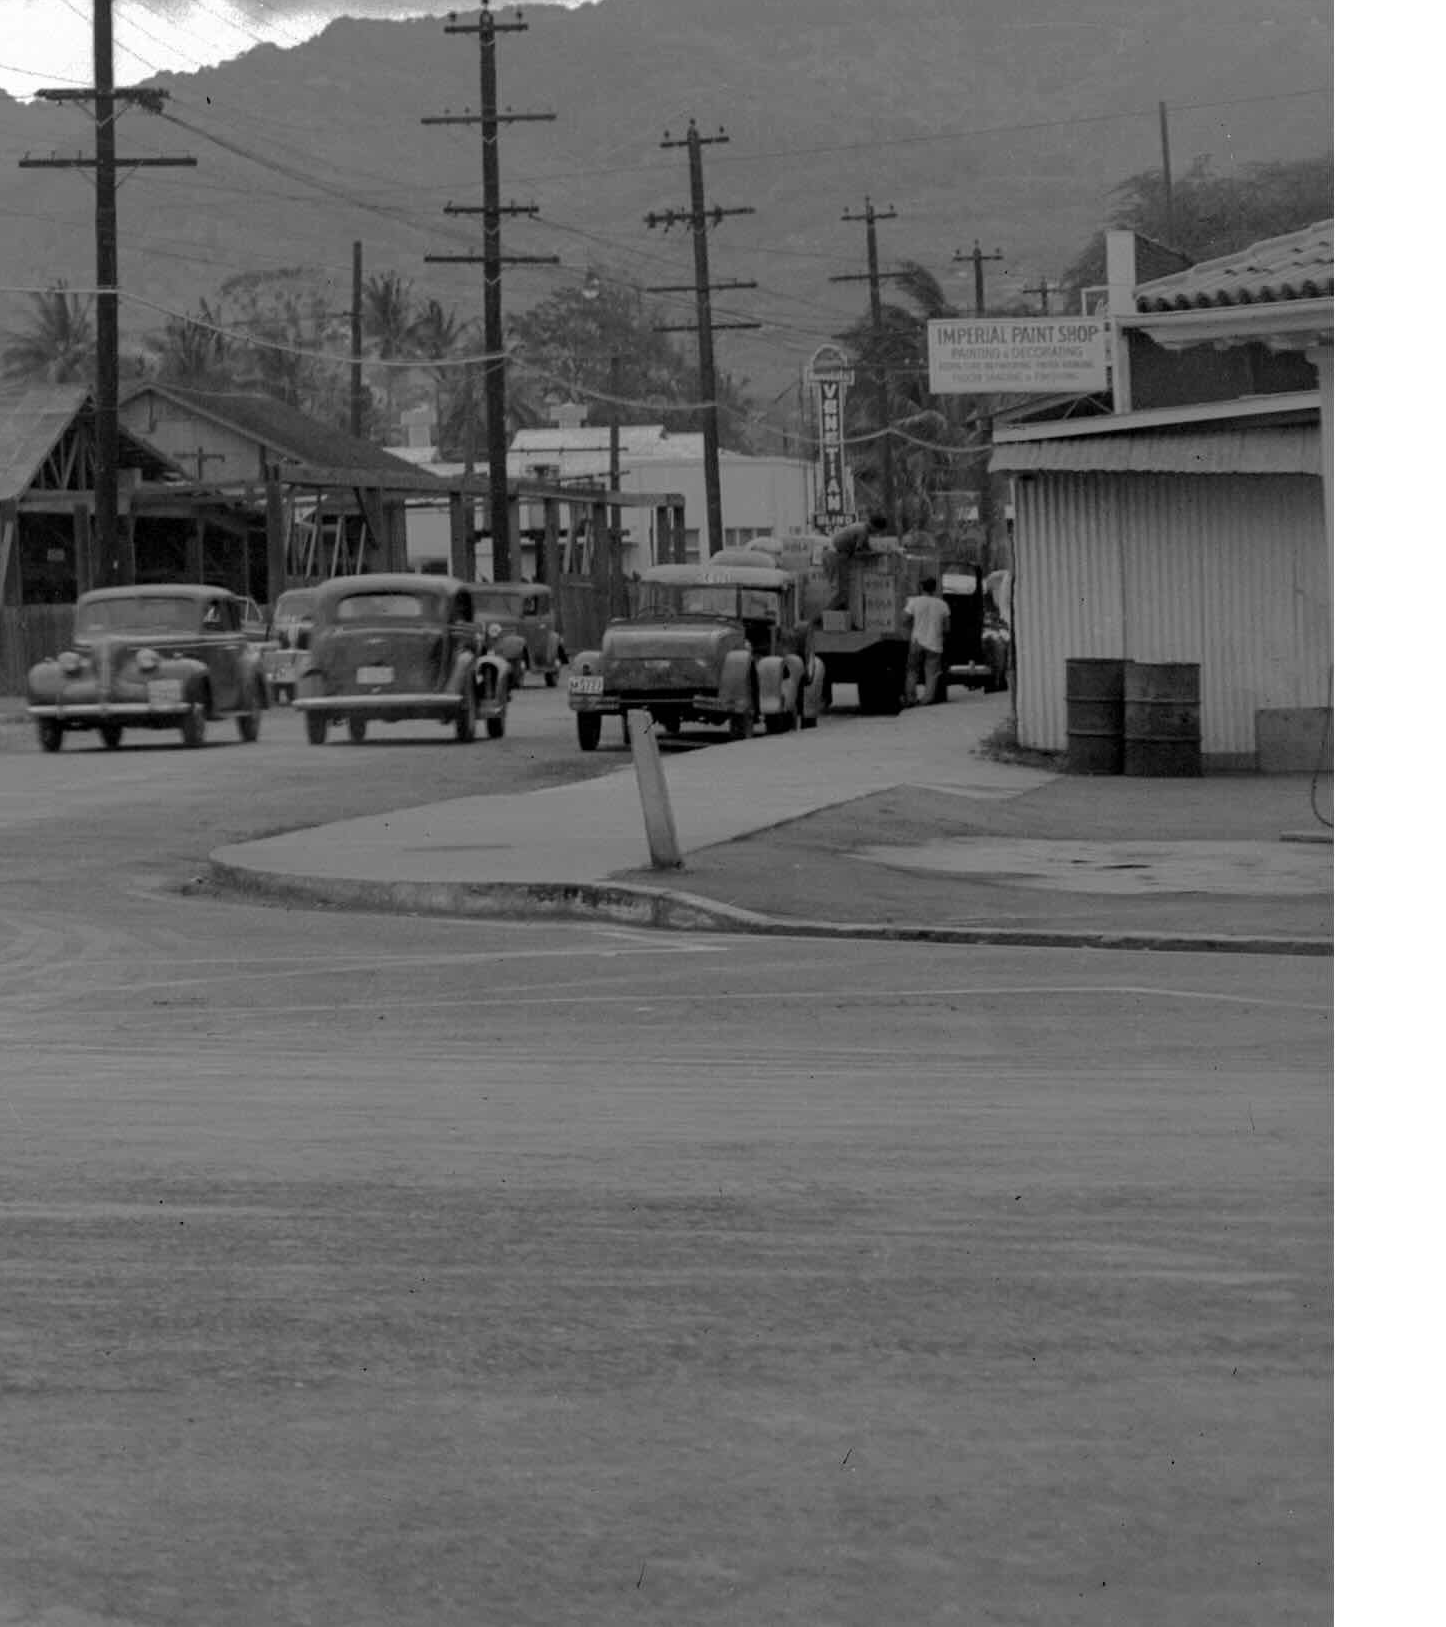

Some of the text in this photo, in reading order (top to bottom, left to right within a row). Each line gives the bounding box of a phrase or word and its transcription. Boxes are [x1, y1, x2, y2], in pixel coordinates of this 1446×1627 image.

[938, 324, 1097, 346] IMPERIAL PAINT SHOP
[951, 347, 1000, 360] PAINTING
[1013, 346, 1083, 359] DECORATING
[823, 382, 841, 511] VENETIAN
[816, 514, 853, 526] BLIND
